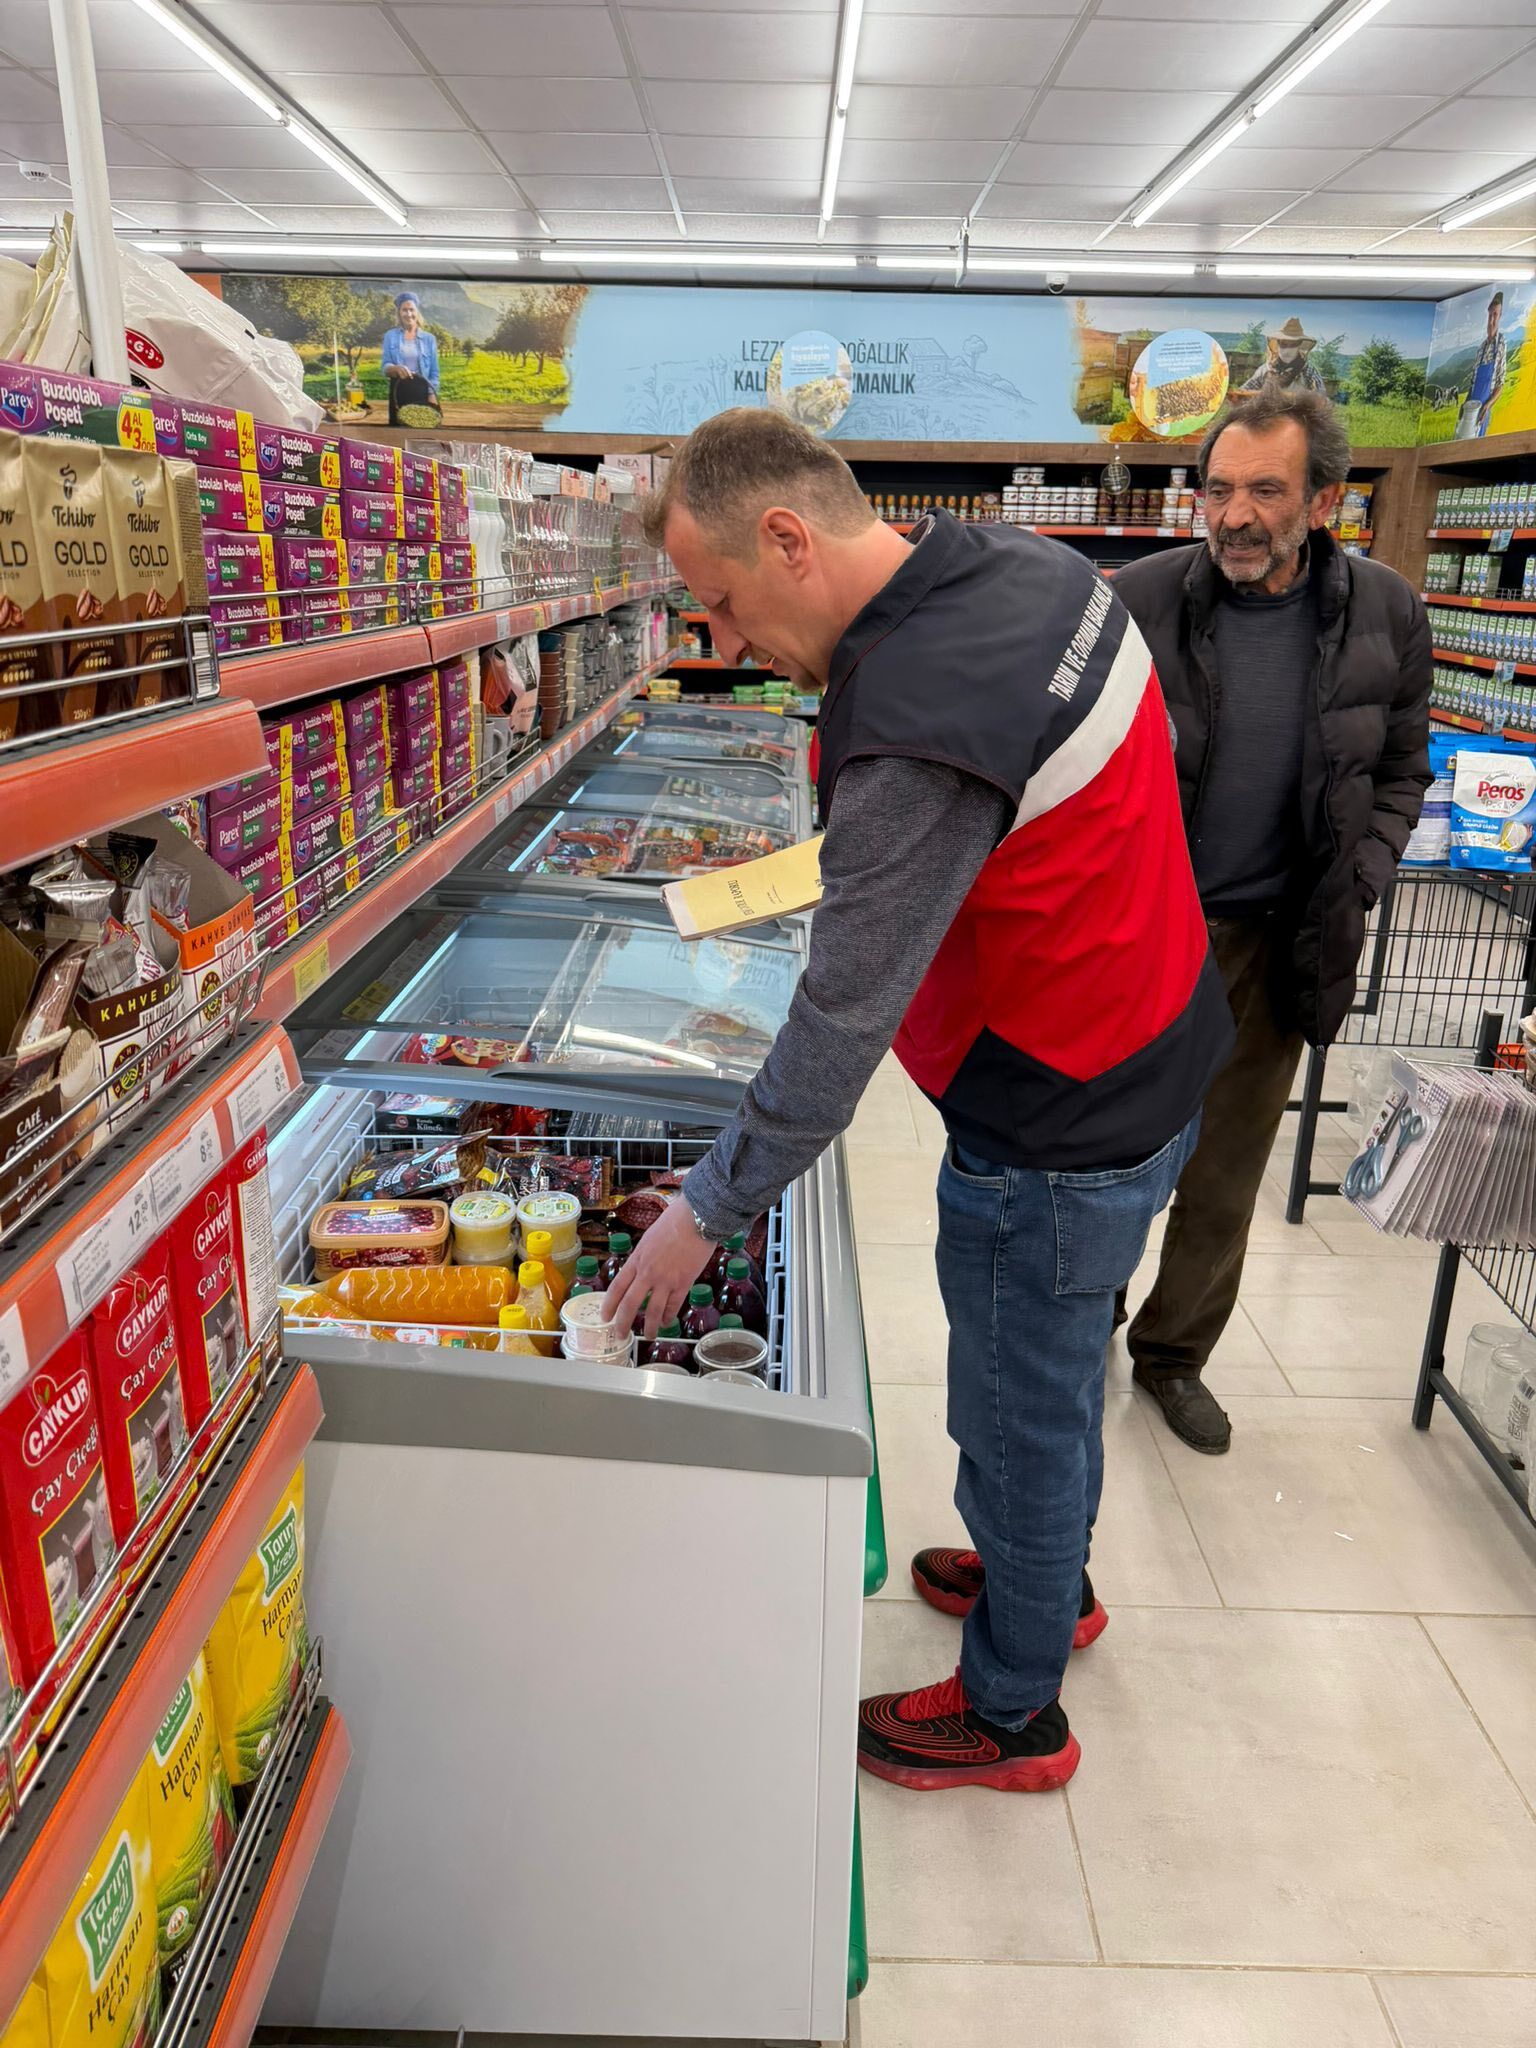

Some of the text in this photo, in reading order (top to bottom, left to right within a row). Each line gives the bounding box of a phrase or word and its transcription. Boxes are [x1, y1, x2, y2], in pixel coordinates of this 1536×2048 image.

[742, 338, 909, 364] LEZZ OĞALLIK
[41, 378, 103, 407] Buzdolabı
[734, 368, 767, 392] KALİ
[853, 373, 917, 394] MANLIK
[1, 387, 33, 409] Parex
[45, 400, 83, 427] Poşeti
[121, 411, 142, 439] 4 AL
[181, 408, 237, 433] Buzdolabı Poşeti
[132, 428, 142, 450] 3
[260, 442, 277, 457] Parex
[281, 435, 314, 454] Buzdolabı
[282, 451, 303, 469] Poşeti
[322, 455, 328, 473] 4
[350, 455, 365, 469] Parex
[199, 478, 243, 495] zdolabı Poşeti
[284, 491, 316, 507] Buzdolabı
[52, 505, 96, 528] Tchibo
[264, 502, 280, 514] Parex
[286, 508, 306, 524] Poşeti
[324, 508, 330, 525] 4
[352, 505, 367, 520] Parex
[127, 513, 160, 533] Tchibo
[0, 541, 28, 567] LD
[54, 541, 107, 566] GOLD
[129, 545, 169, 567] GOLD
[218, 545, 245, 557] Buzdolabı
[290, 555, 307, 571] Parex
[67, 568, 101, 577] SELECTION
[1070, 615, 1101, 660] ORMAN
[1062, 647, 1086, 673] VE
[1047, 662, 1081, 702] TARIM
[1477, 781, 1526, 801] Peros
[243, 793, 280, 822] Buzdolabı Poşeti
[219, 826, 239, 847] Parex
[240, 848, 279, 878] Buzdolabı Poşeti
[191, 926, 225, 951] KAHVE
[101, 990, 157, 1022] KAHVE
[16, 1106, 42, 1137] CAFÉ
[197, 1203, 230, 1256] ÇAYKU
[197, 1269, 219, 1300] Çay
[122, 1283, 168, 1351] ÇAYKUR
[121, 1365, 146, 1400] Çay
[29, 1377, 88, 1459] ÇAYKUR
[31, 1418, 98, 1517] Çay Çiçeği
[160, 1711, 204, 1802] Harman
[182, 1752, 202, 1802] Çay
[84, 1854, 129, 1932] Tarım
[96, 1880, 130, 1956] Kredi
[88, 1911, 143, 2034] Harman
[107, 1963, 131, 2026] Çay
